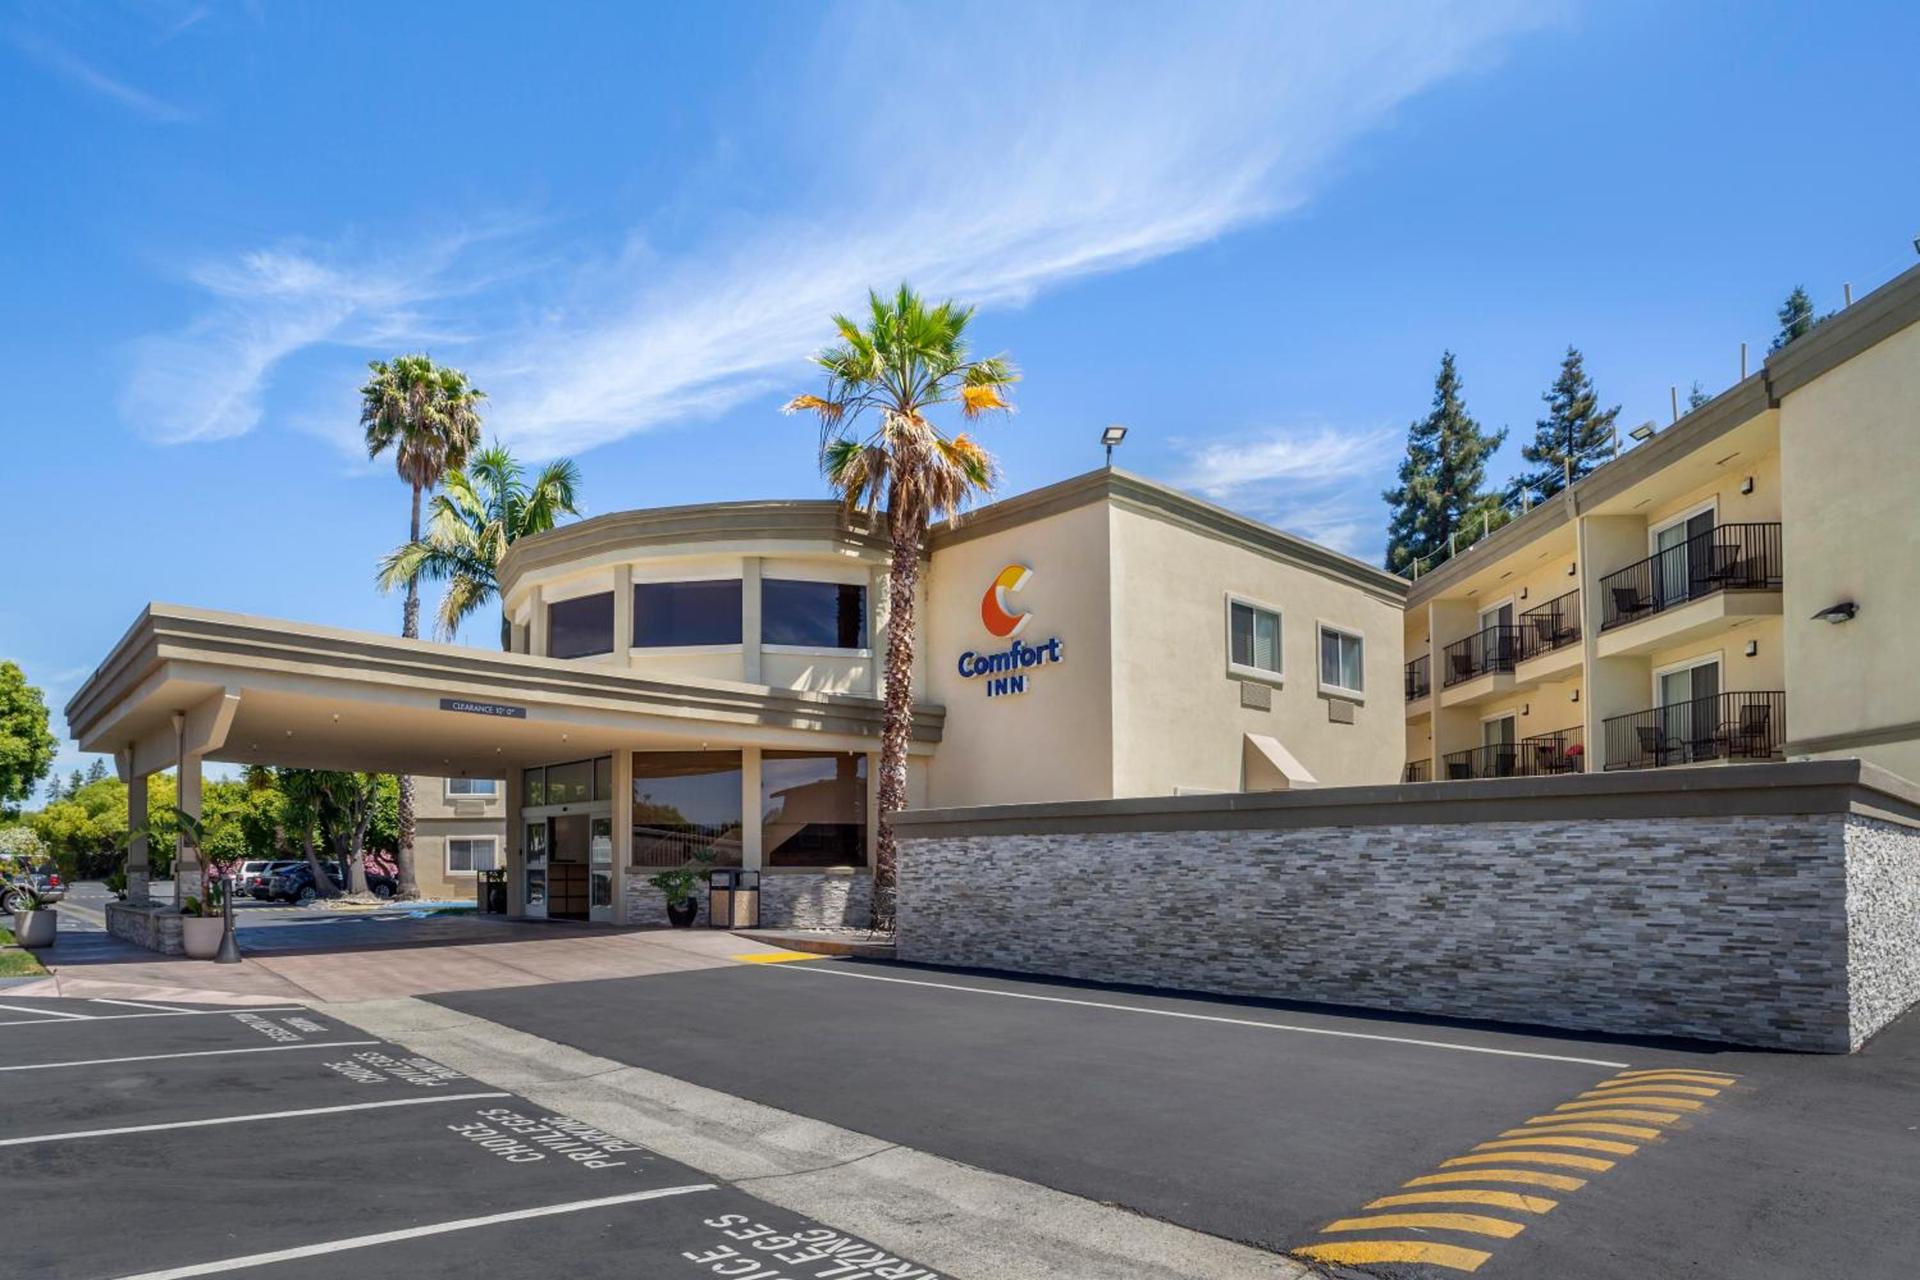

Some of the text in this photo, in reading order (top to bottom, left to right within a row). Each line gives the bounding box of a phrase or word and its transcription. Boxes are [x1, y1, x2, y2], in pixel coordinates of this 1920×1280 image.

[958, 637, 1062, 678] Comfort
[987, 675, 1026, 697] INN
[452, 702, 494, 714] CLEARANCE
[447, 1122, 546, 1162] CHOICE
[476, 1108, 627, 1169] PRIVILEGES
[681, 1244, 793, 1280] ICE
[704, 1214, 874, 1280] ILEGES
[793, 1229, 938, 1280] RKING
